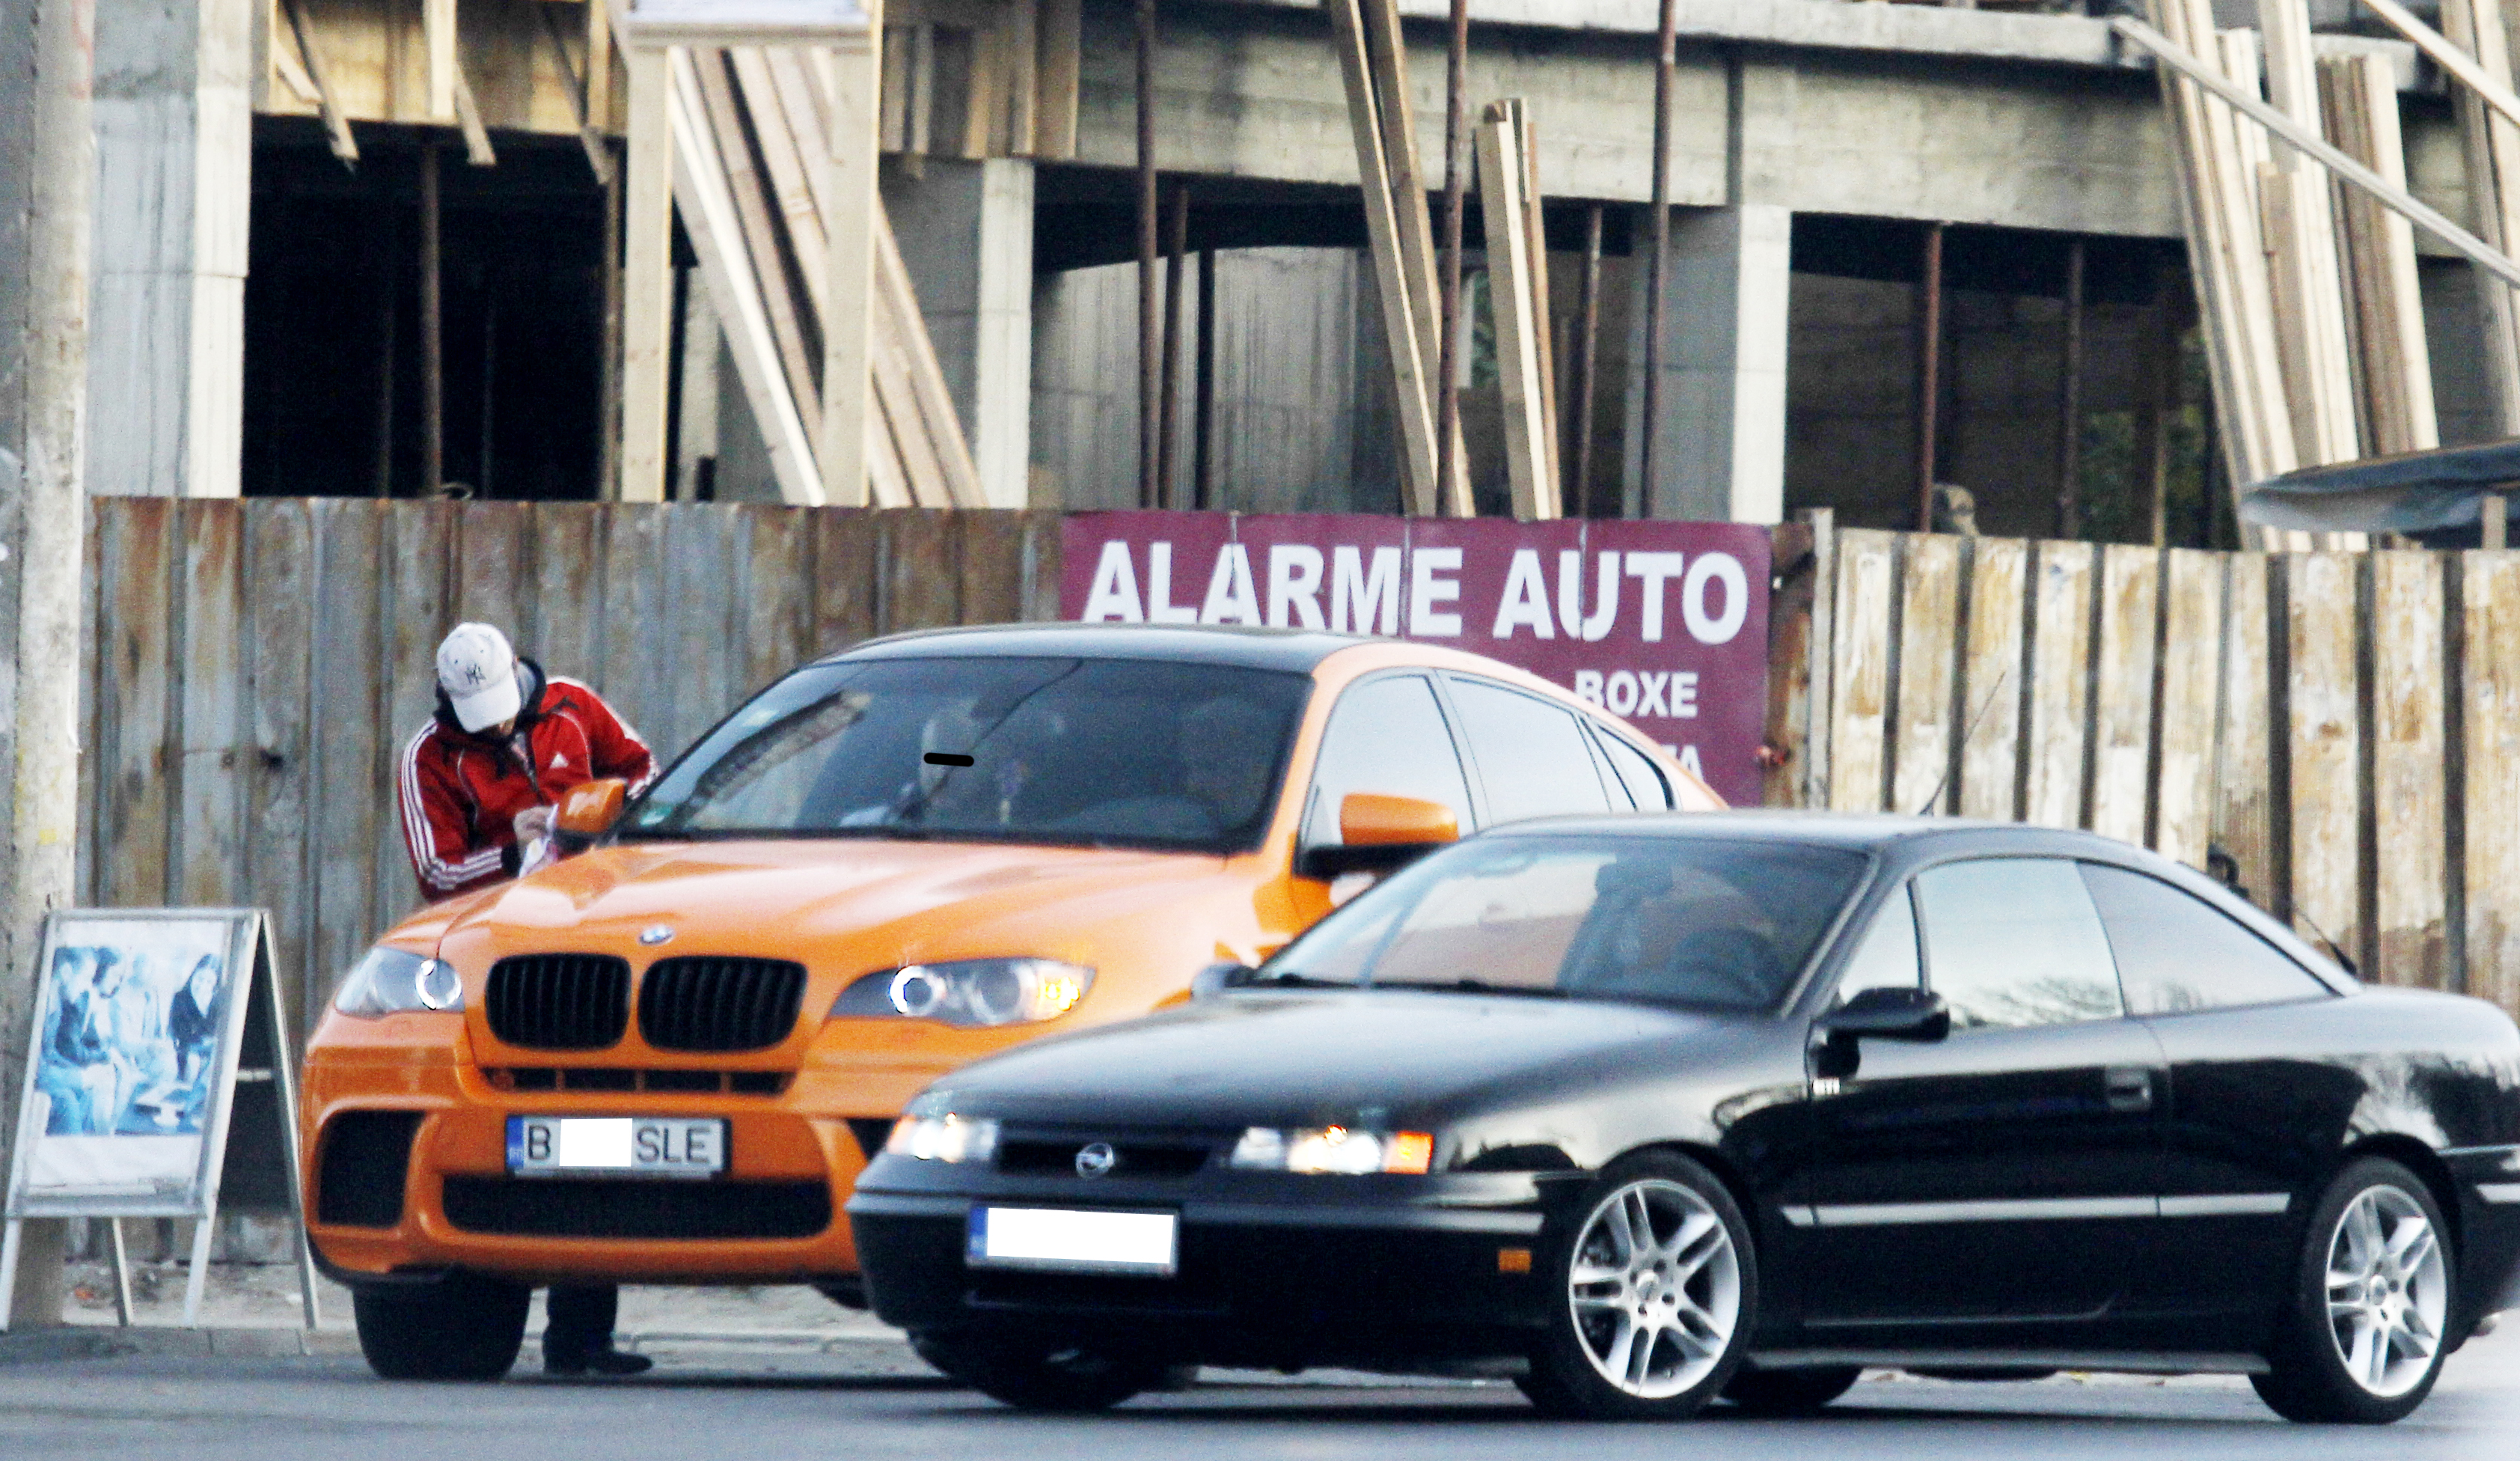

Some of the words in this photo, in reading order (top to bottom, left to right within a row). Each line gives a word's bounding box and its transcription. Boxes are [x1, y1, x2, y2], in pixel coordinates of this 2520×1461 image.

[1081, 540, 1464, 636] ALARME
[1493, 549, 1749, 644] AUTO
[1574, 669, 1699, 719] BOXE
[528, 1125, 551, 1161] B
[637, 1126, 711, 1162] SLE
